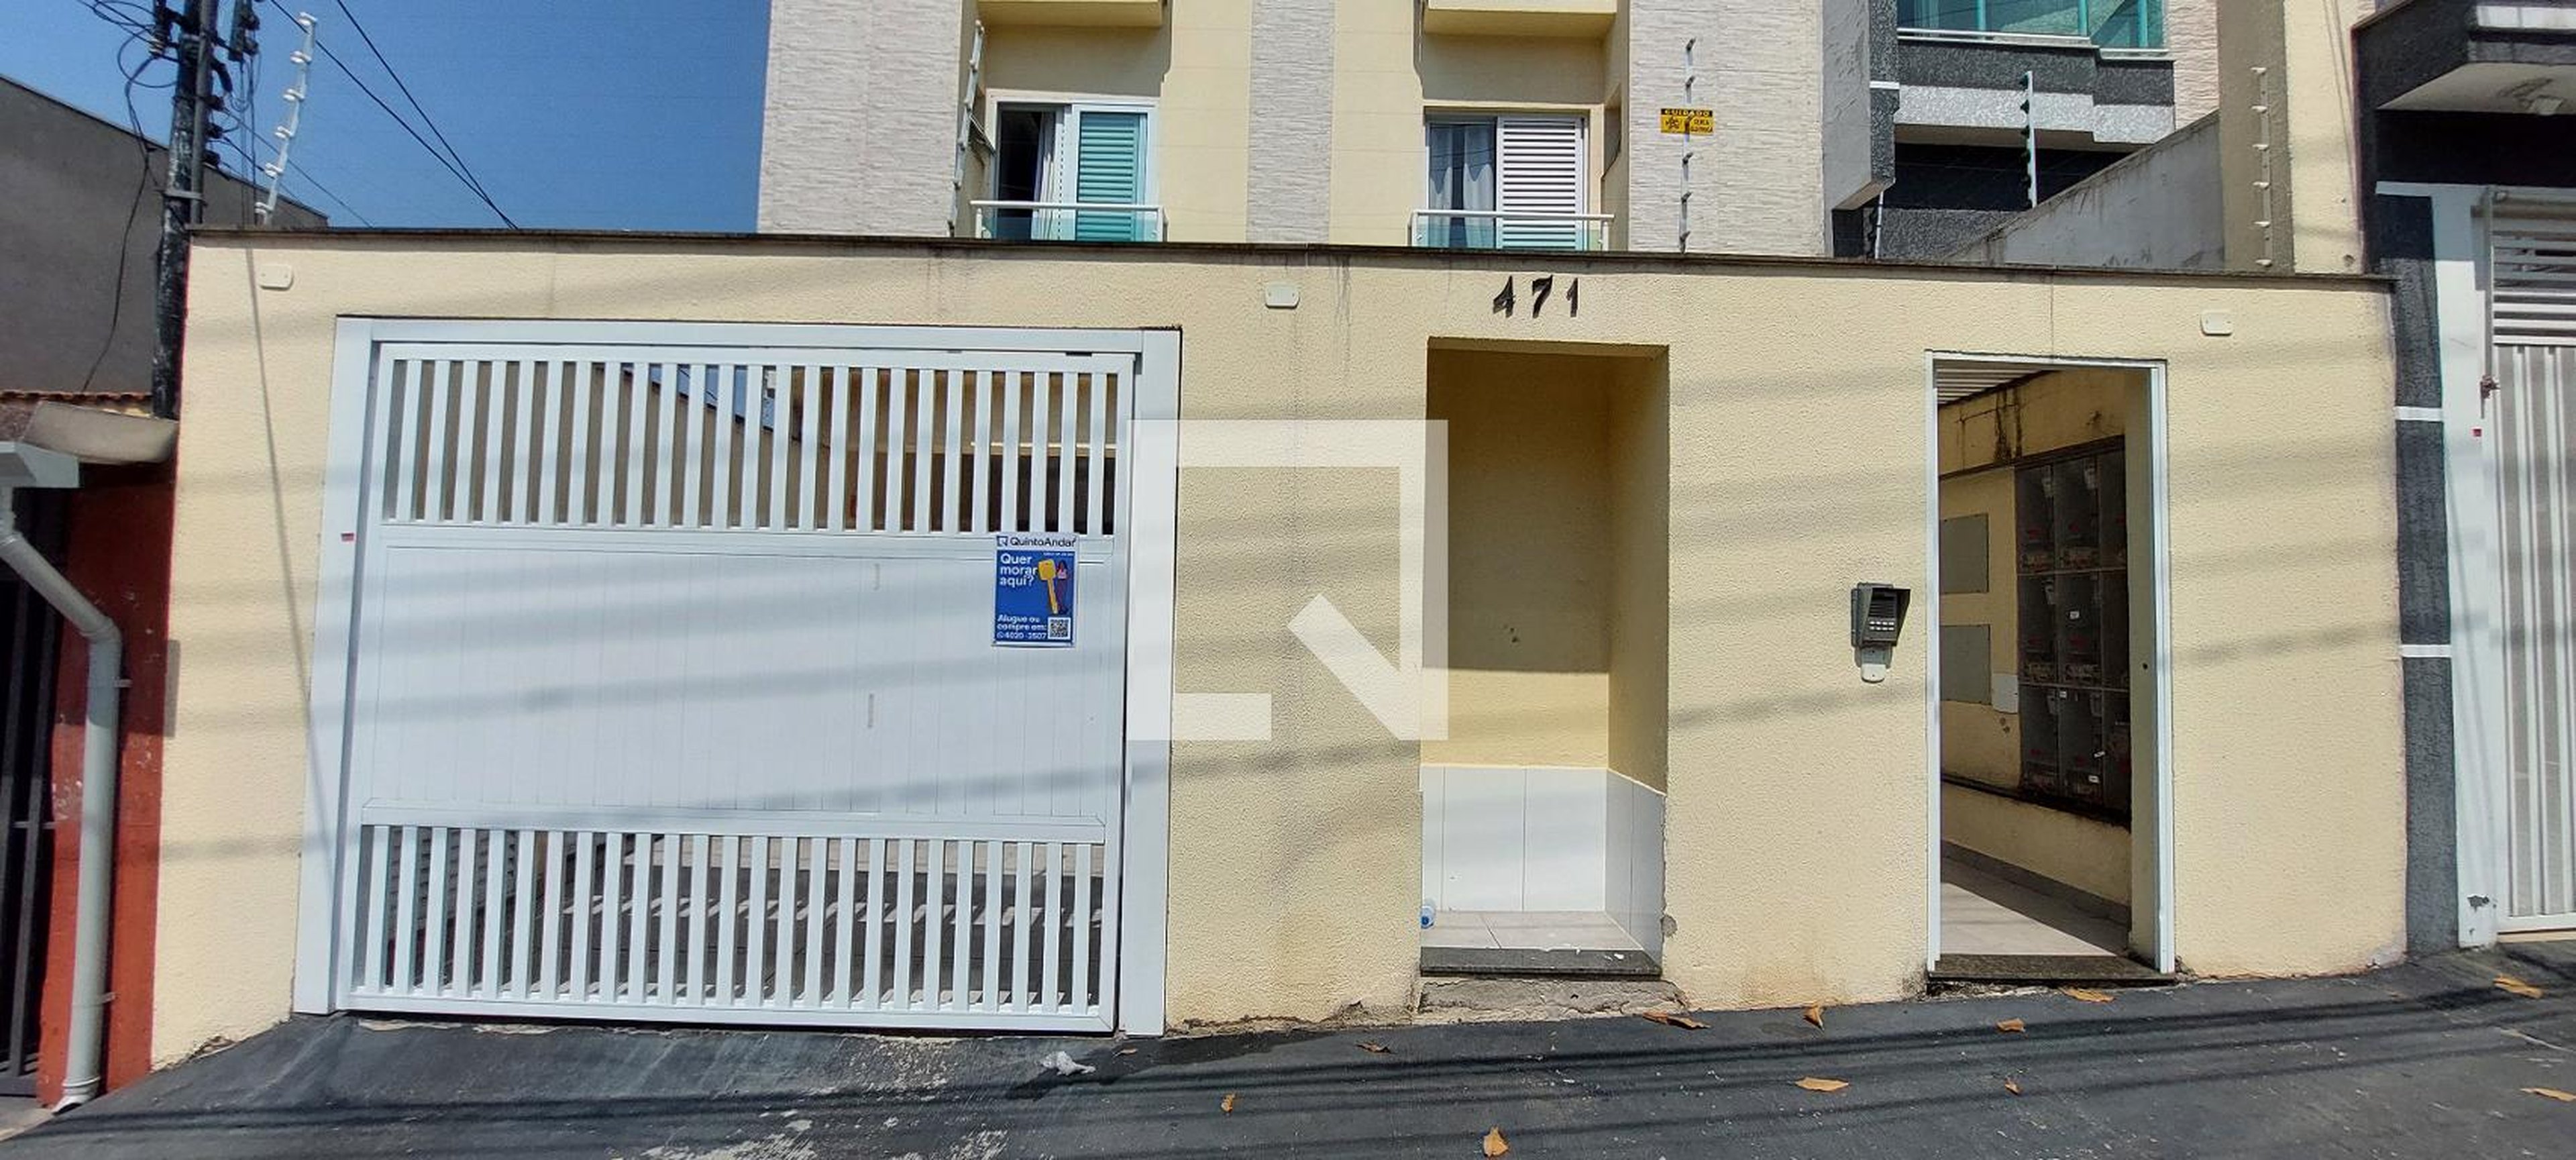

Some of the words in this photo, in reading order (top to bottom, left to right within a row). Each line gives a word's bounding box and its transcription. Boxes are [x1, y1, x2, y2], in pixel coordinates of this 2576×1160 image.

[1493, 274, 1579, 319] 471
[1010, 536, 1076, 547] QuintoAndar
[1000, 553, 1032, 564] Quer
[1000, 566, 1038, 576] morar
[1000, 576, 1034, 588] aqui?
[998, 614, 1028, 624] Alugue
[997, 623, 1030, 632] compre
